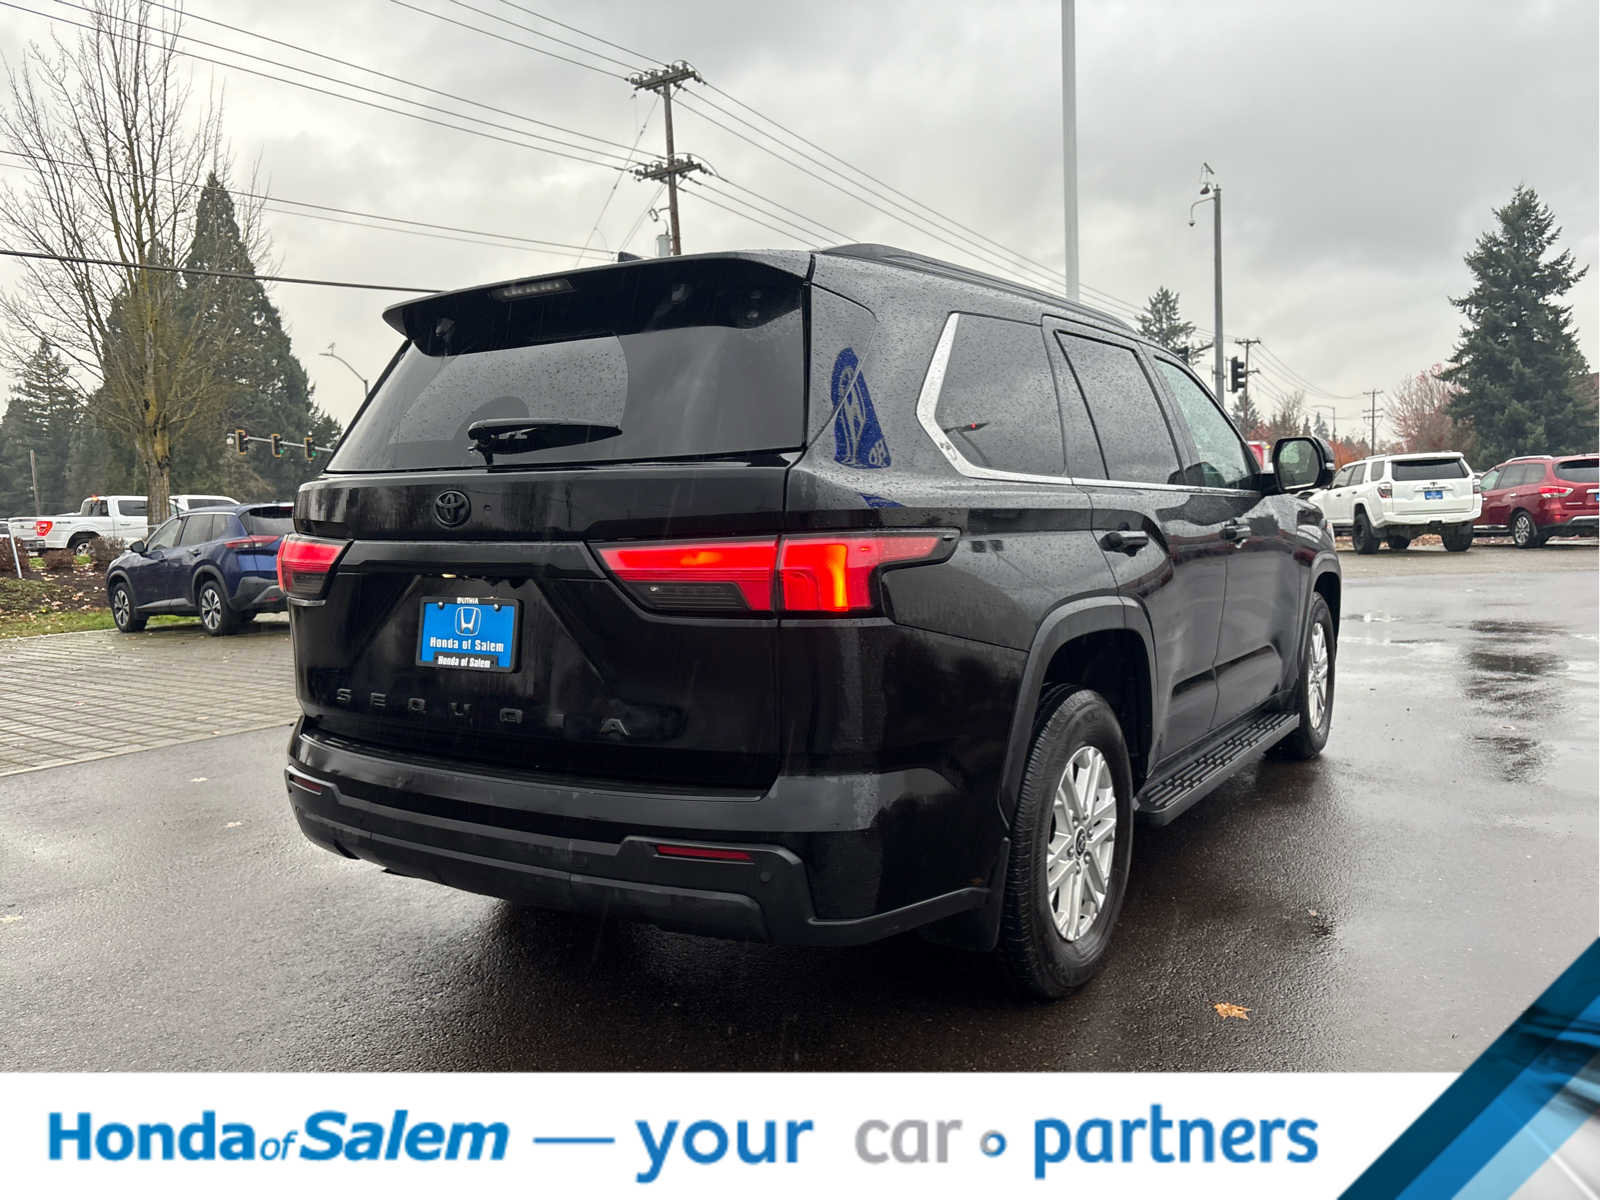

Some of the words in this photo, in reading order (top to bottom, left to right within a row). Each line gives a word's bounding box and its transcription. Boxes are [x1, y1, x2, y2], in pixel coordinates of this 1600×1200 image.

[429, 636, 459, 649] Honda
[462, 639, 472, 650] of
[475, 640, 505, 652] Salem
[437, 655, 459, 666] Honda
[460, 657, 469, 667] of
[469, 658, 491, 668] Salem
